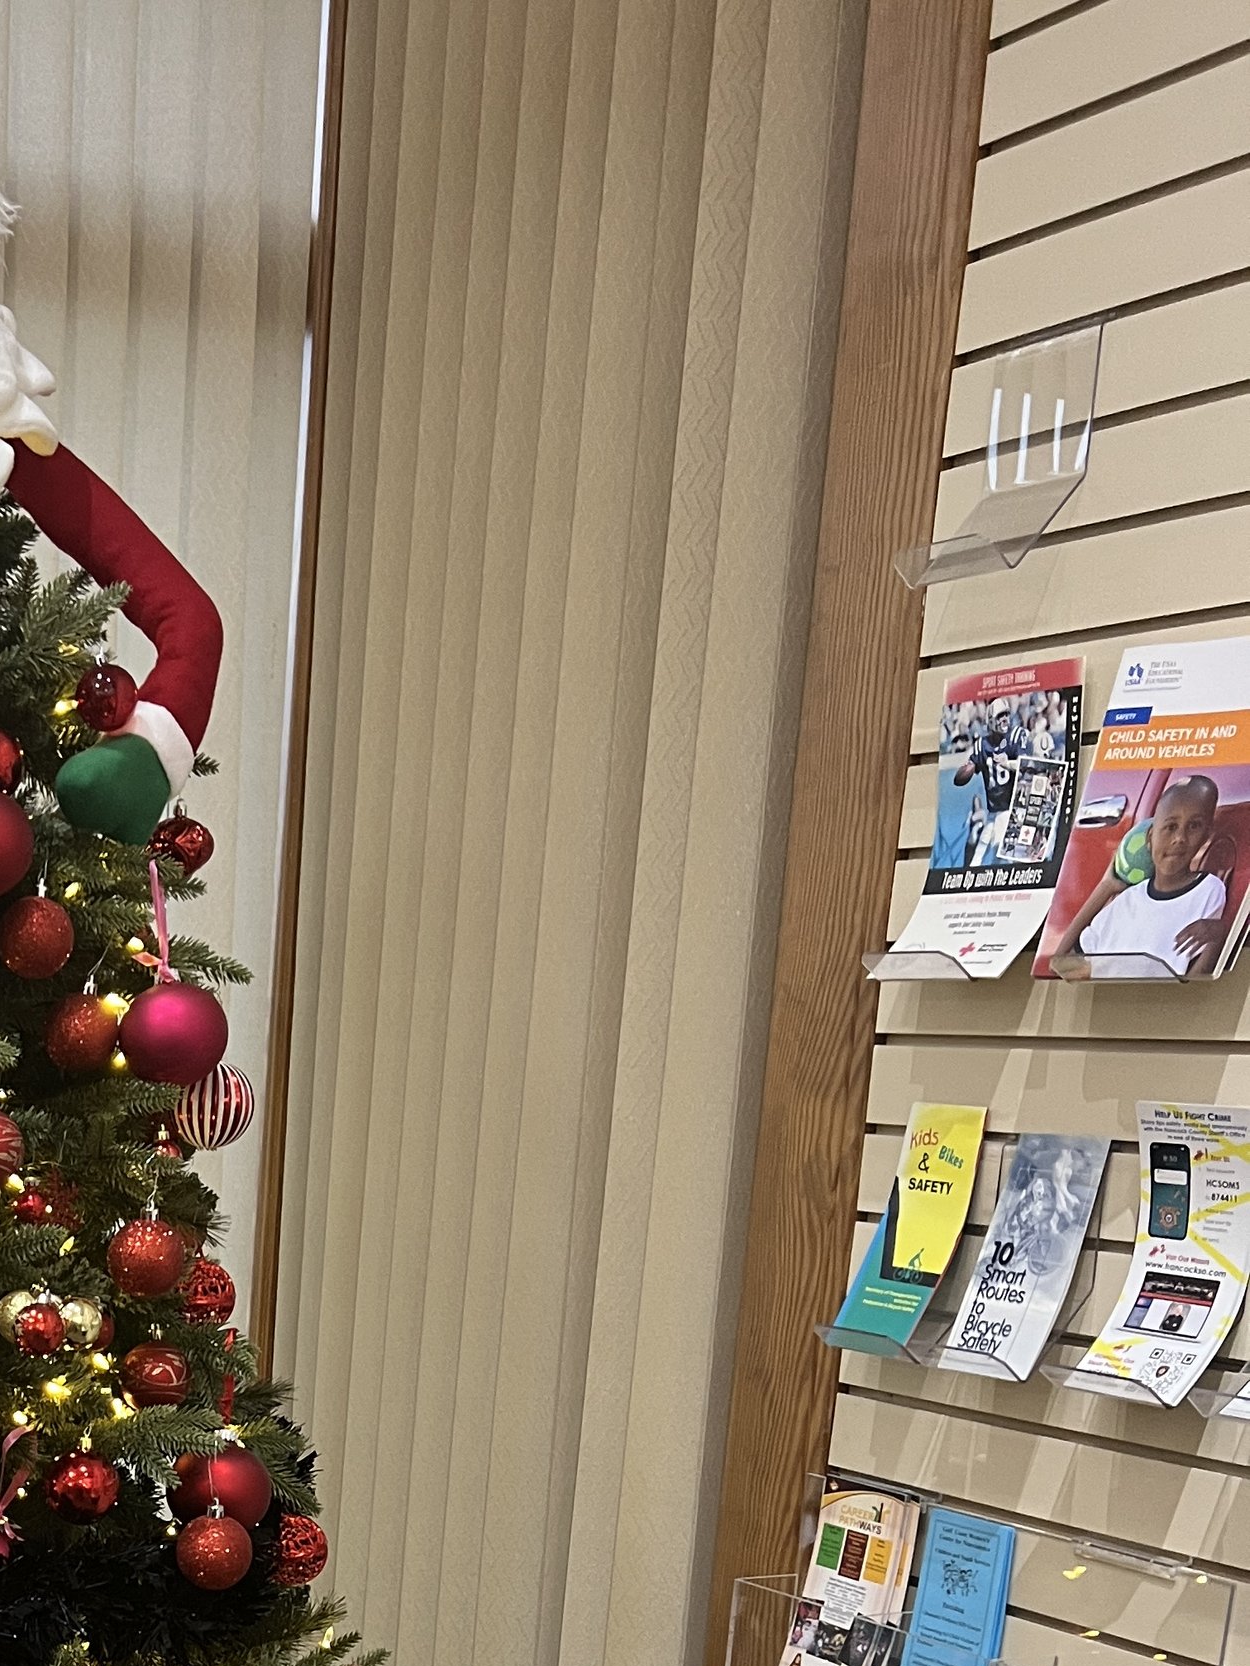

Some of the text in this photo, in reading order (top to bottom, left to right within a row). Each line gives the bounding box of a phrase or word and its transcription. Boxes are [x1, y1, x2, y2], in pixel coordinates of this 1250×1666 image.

[1109, 724, 1237, 744] CHILD SAFETY IN AND
[1104, 743, 1216, 761] AROUND VEHICLES
[941, 866, 1043, 891] Team Up with the Leaders
[910, 1128, 939, 1150] Kids
[917, 1152, 930, 1174] &
[938, 1145, 964, 1169] Bikes
[908, 1177, 954, 1195] SAFETY
[991, 1240, 1015, 1266] 10
[981, 1264, 1027, 1286] Smart
[1145, 1261, 1227, 1278] www.hancockso.com
[976, 1280, 1026, 1304] Routes
[970, 1298, 985, 1315] to
[964, 1314, 1012, 1338] Bicycle
[957, 1331, 1002, 1354] Safety
[840, 1504, 876, 1519] CAREER
[838, 1515, 882, 1535] PATHWAYS
